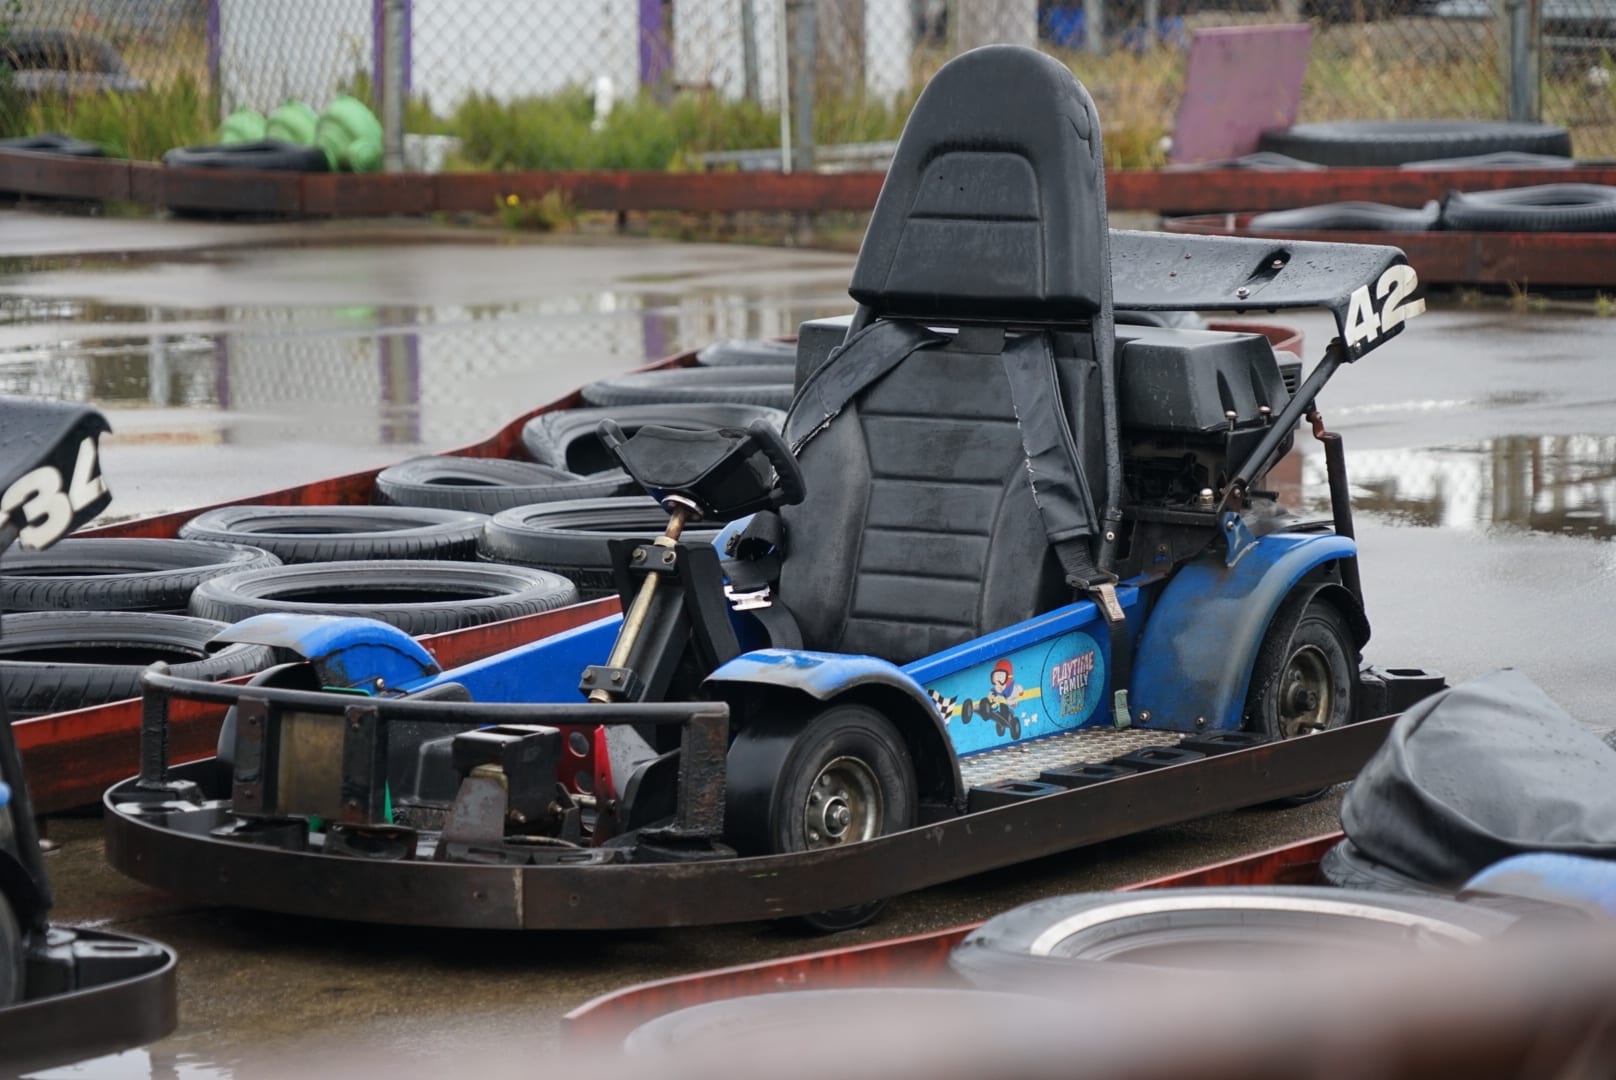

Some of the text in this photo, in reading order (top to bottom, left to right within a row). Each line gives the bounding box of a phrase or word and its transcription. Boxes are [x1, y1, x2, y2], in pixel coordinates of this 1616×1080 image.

[1344, 264, 1426, 347] 42
[1051, 650, 1094, 688] PLAYTIME
[1059, 670, 1089, 695] FAMILY
